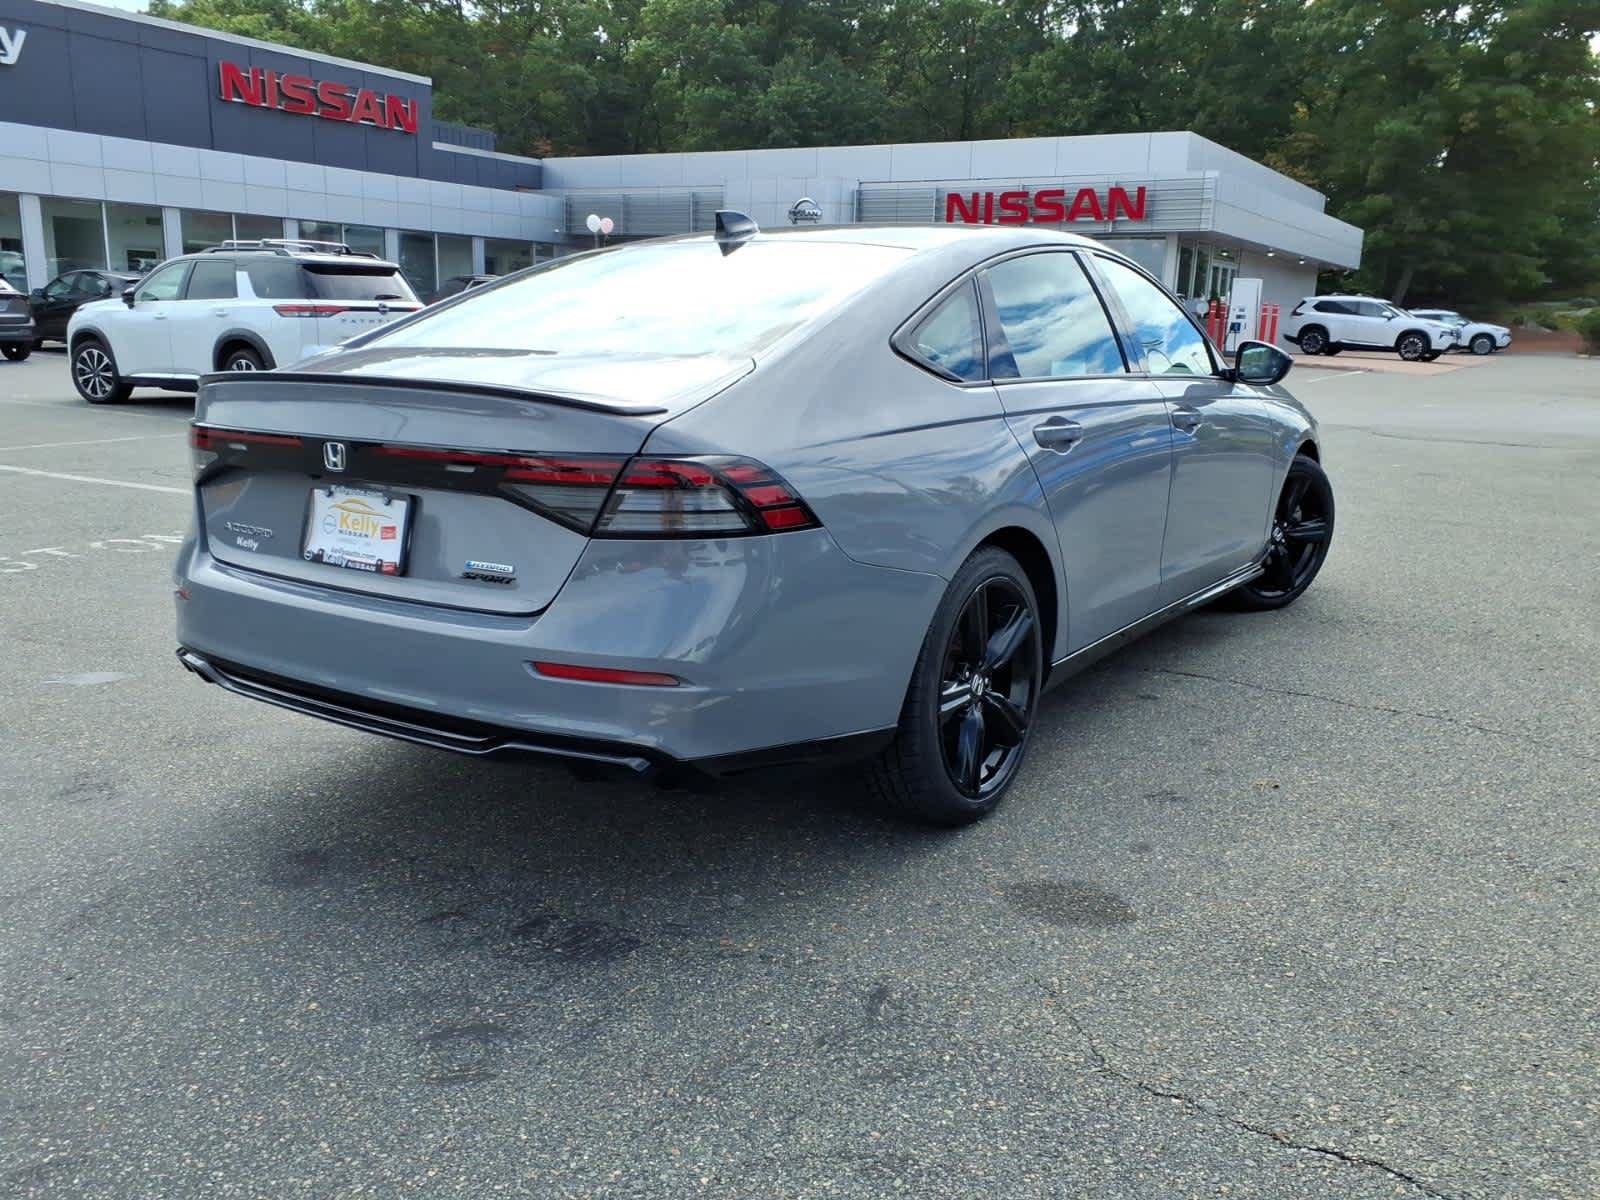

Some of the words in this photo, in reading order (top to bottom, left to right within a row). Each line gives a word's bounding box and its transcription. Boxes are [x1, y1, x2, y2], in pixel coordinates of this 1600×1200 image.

[219, 60, 418, 133] NISSAN
[946, 186, 1146, 224] NISSAN
[340, 512, 380, 538] Kelly
[236, 536, 258, 551] Kelly
[462, 571, 516, 584] SPORT
